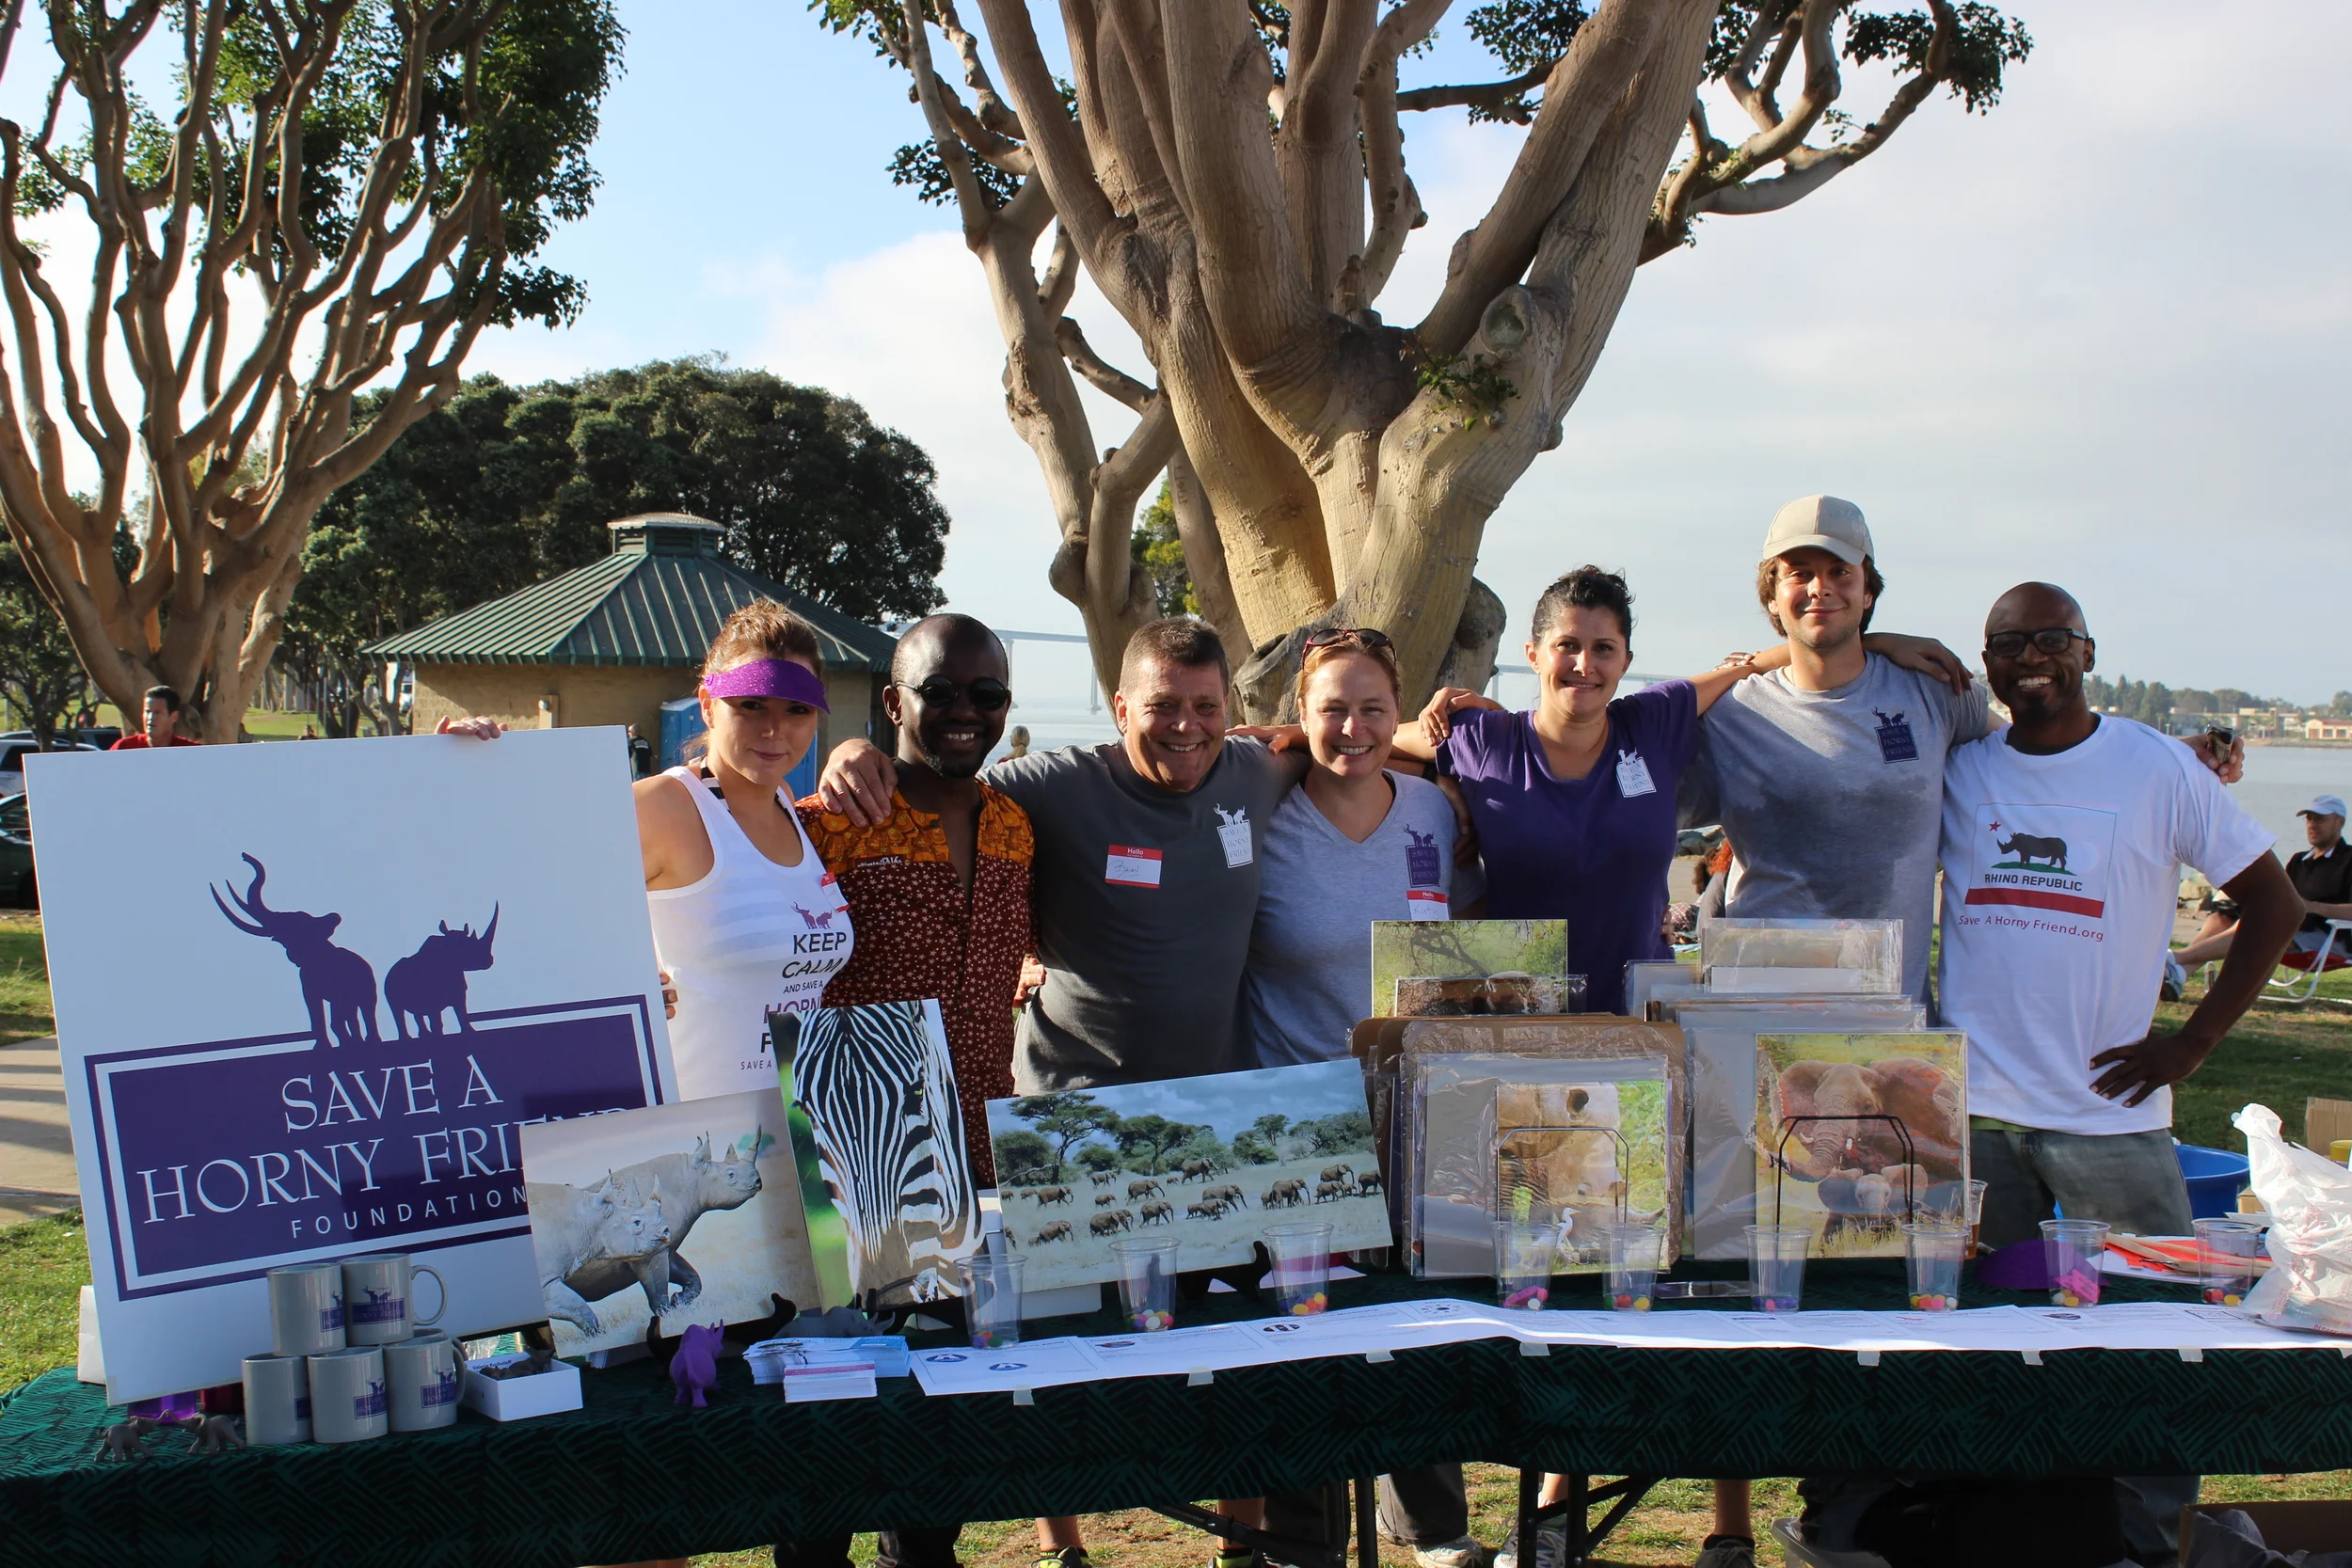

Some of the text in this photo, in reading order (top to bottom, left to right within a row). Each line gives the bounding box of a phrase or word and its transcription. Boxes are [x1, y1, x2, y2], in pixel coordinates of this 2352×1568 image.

[1885, 745, 1914, 755] FRIEND
[1127, 847, 1144, 856] Hello
[1413, 871, 1438, 879] FRIEND
[1984, 873, 2083, 892] RHINO REPUBLIC
[1958, 915, 2104, 942] Save A Horny Friend.org
[793, 931, 847, 955] KEEP
[782, 958, 844, 979] CALM
[783, 981, 801, 994] AND
[802, 980, 818, 990] SAVE
[740, 1059, 772, 1070] SAVE A
[282, 1053, 504, 1133] SAVE A
[135, 1107, 628, 1225] HORNY FRI
[291, 1185, 526, 1239] FOUNDATION
